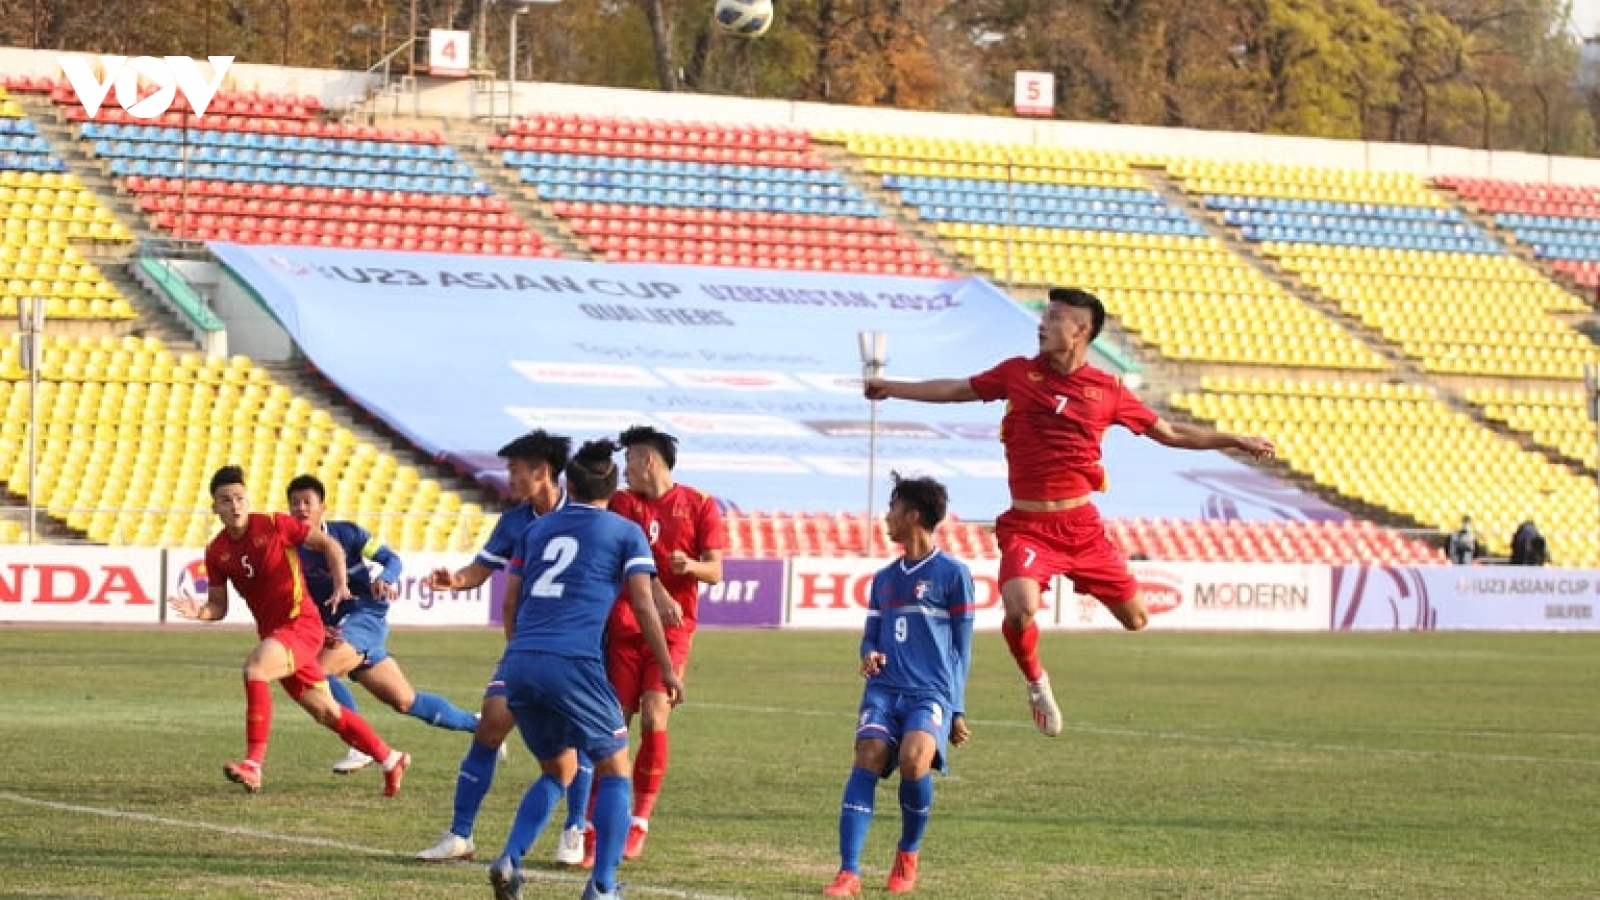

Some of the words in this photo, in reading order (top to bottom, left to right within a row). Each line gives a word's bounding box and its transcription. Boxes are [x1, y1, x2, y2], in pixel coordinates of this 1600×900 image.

[441, 39, 456, 61] 4
[1026, 80, 1041, 100] 5
[329, 265, 429, 286] U23
[438, 270, 584, 294] ASIAN
[586, 277, 683, 299] CUP
[1054, 394, 1069, 415] 7
[649, 519, 660, 545] 9
[241, 555, 255, 578] 5
[530, 534, 580, 599] 2
[1023, 546, 1037, 568] 7
[697, 580, 760, 602] PORT
[1194, 582, 1310, 608] MODERN
[1508, 578, 1555, 595] ASIAN
[1557, 579, 1590, 595] CUP
[895, 615, 907, 643] 9
